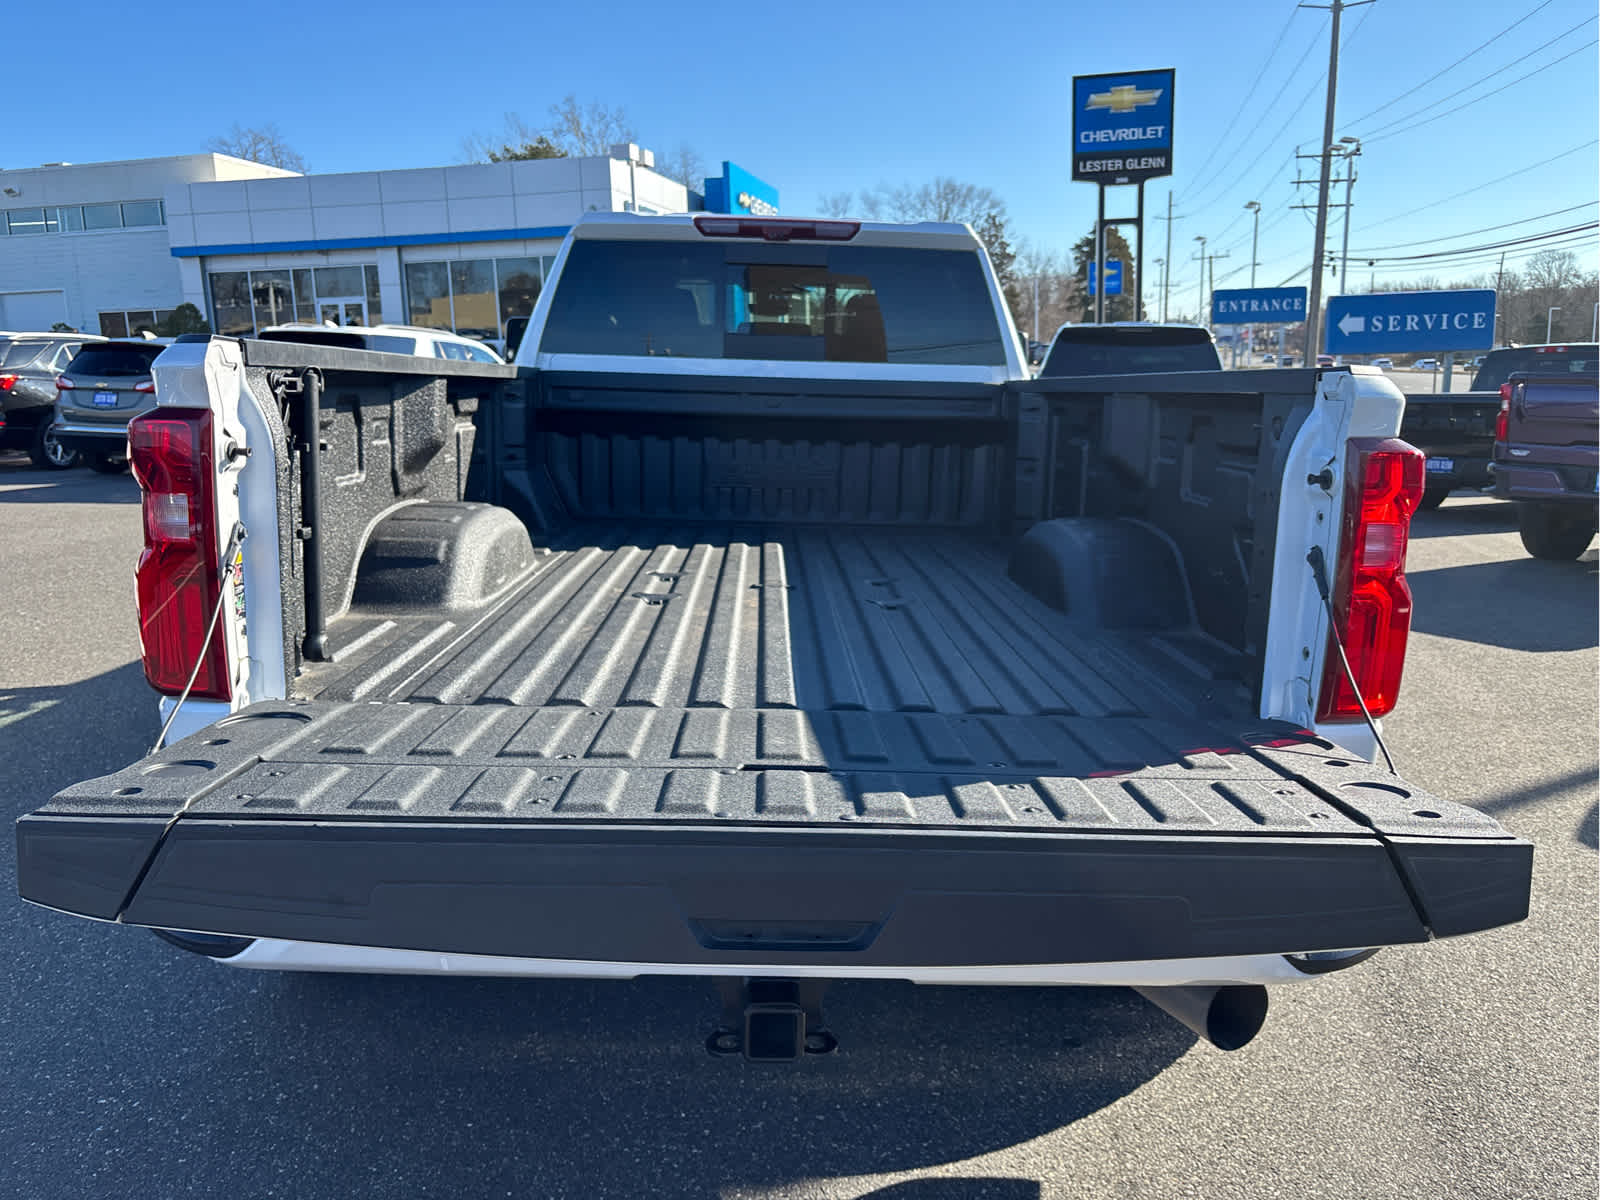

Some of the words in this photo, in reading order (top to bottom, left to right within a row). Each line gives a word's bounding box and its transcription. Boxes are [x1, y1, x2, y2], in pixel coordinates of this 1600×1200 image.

[1081, 126, 1164, 143] CHEVROLET
[1080, 159, 1122, 172] LESTER
[1126, 157, 1165, 170] GLENN
[1218, 298, 1302, 313] ENTRANCE
[1371, 312, 1486, 332] SERVICE
